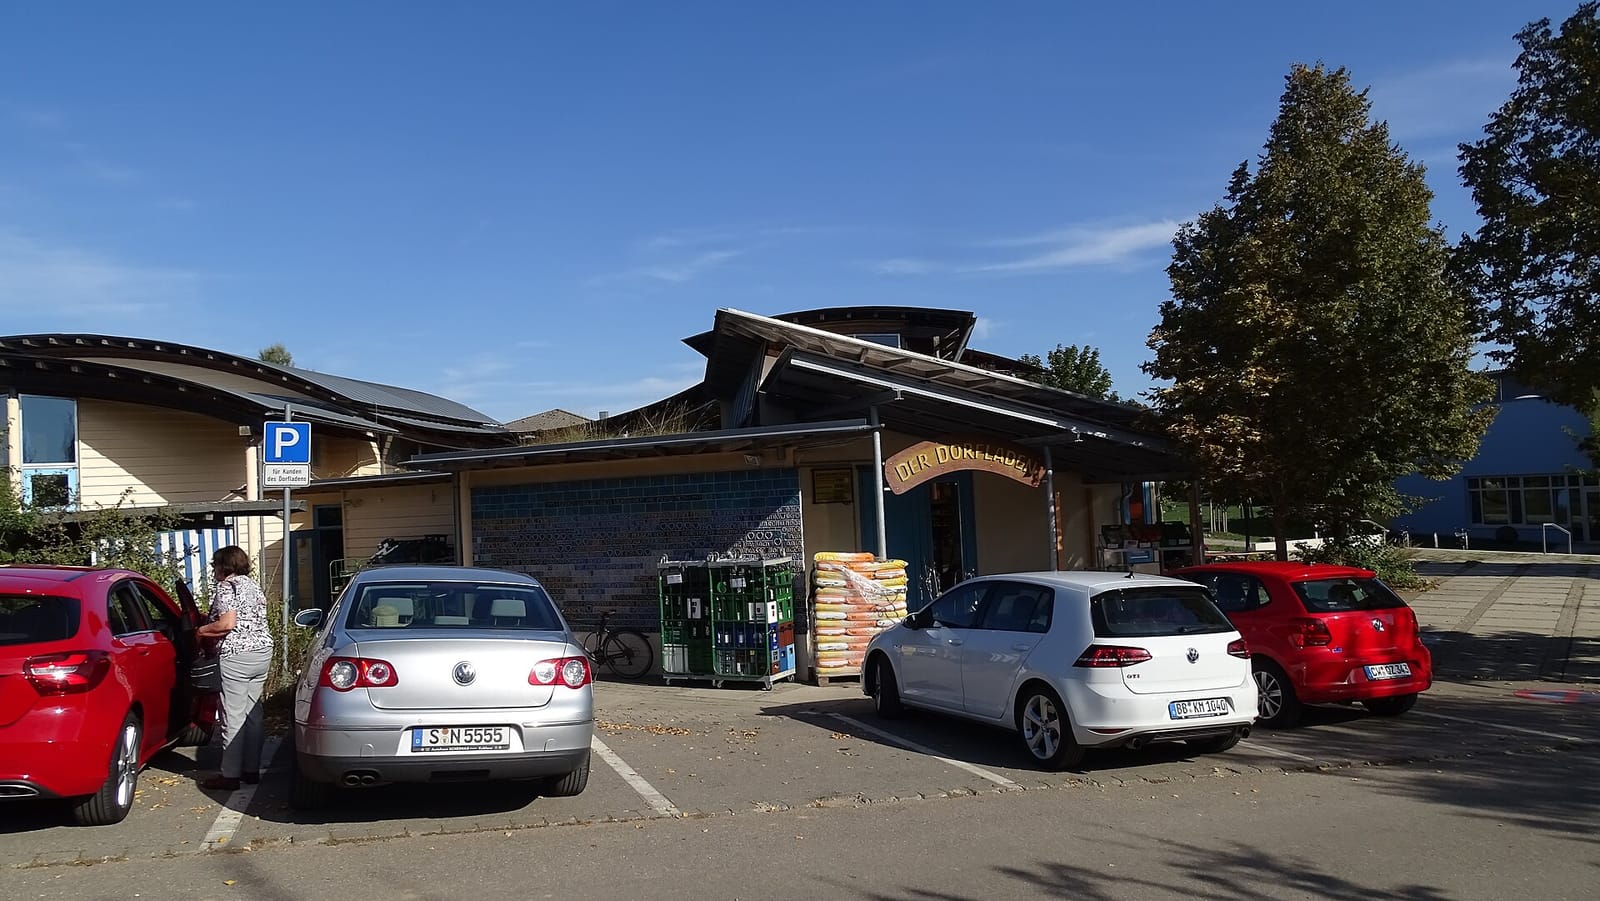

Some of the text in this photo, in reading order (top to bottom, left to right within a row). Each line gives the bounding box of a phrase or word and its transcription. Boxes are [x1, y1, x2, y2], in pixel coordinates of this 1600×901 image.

[275, 427, 299, 458] P
[894, 443, 1038, 482] DER DORFLADEN
[1176, 703, 1188, 715] BB
